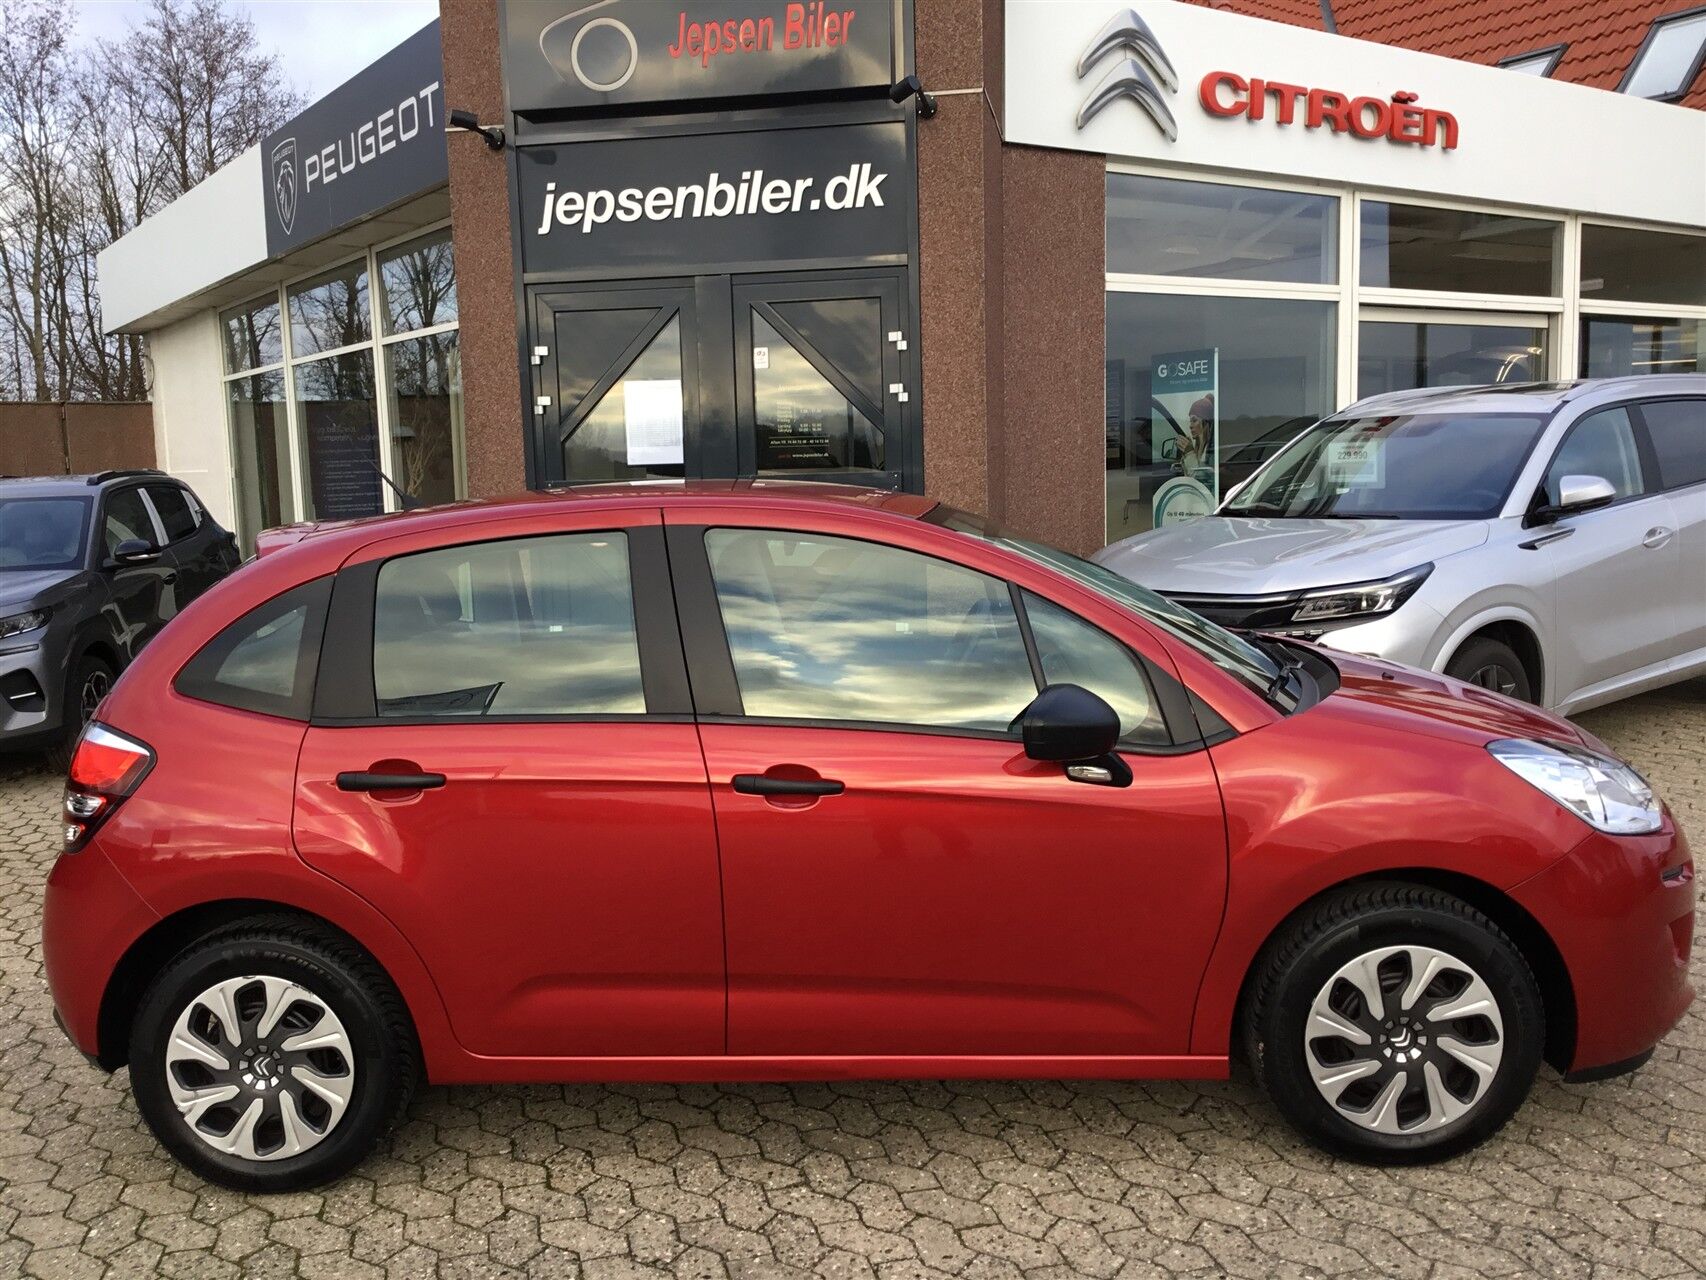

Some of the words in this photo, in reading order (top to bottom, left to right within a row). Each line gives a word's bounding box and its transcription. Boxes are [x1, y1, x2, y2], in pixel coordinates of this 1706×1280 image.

[666, 11, 774, 68] Jepsen
[783, 1, 857, 50] Biler
[304, 80, 440, 194] PEUGEOT
[537, 162, 889, 236] jepsenbiler.dk
